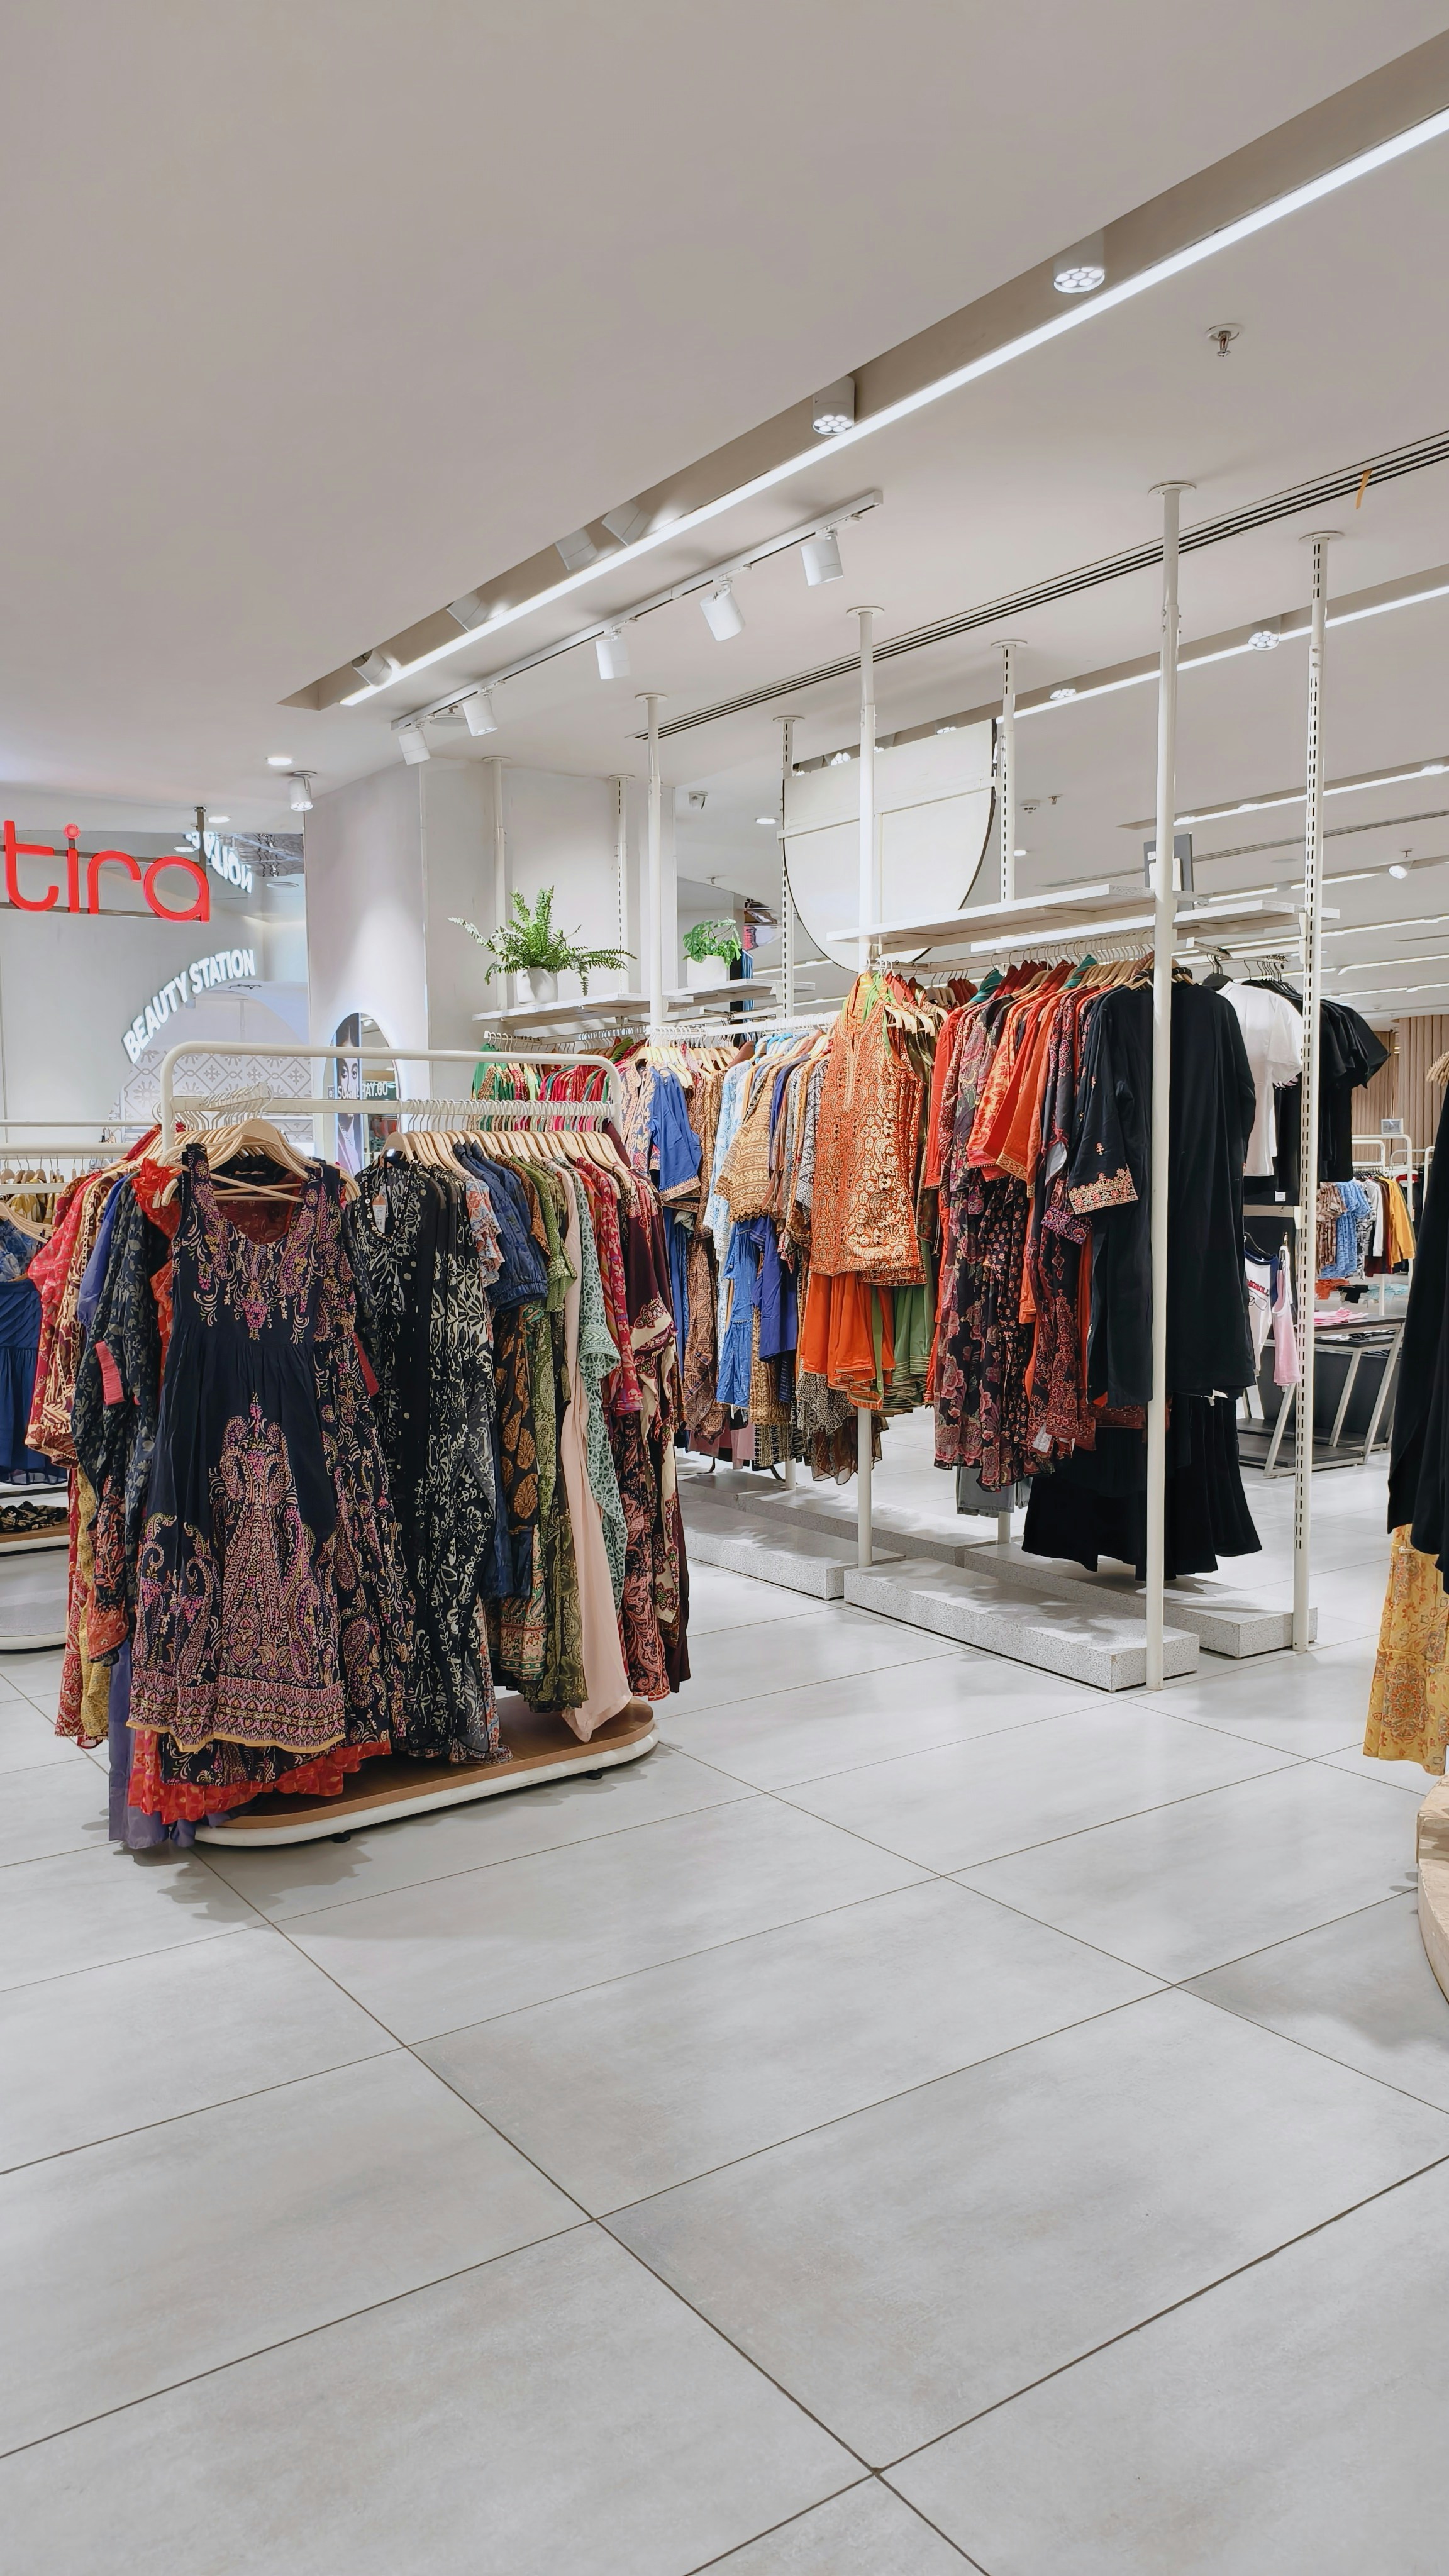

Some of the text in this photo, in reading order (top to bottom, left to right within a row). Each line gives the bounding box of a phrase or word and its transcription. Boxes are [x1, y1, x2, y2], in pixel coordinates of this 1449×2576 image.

[4, 820, 209, 923] tira
[122, 949, 255, 1064] BEAUTY STATION
